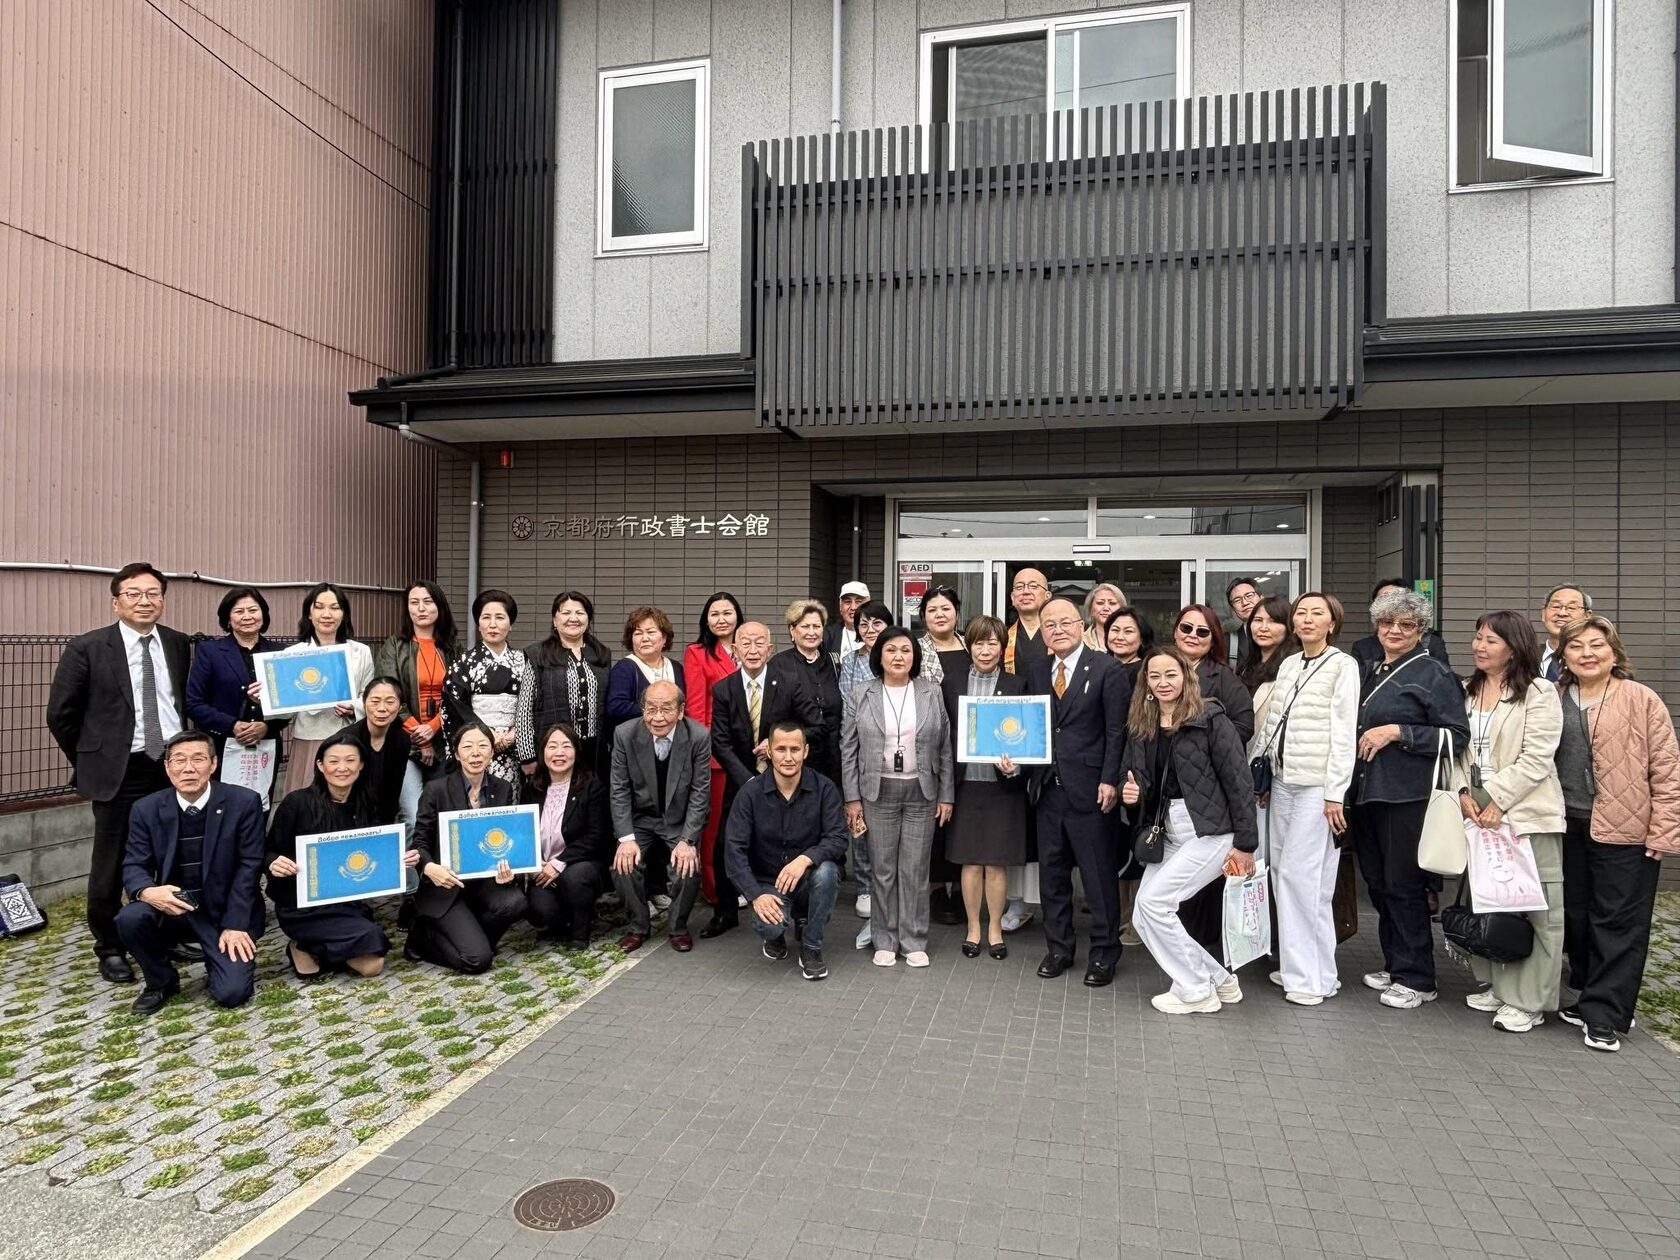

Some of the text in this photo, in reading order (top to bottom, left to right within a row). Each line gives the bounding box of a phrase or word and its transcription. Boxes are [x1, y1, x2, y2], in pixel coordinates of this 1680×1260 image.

[542, 513, 770, 538] 京都府行政書士会館
